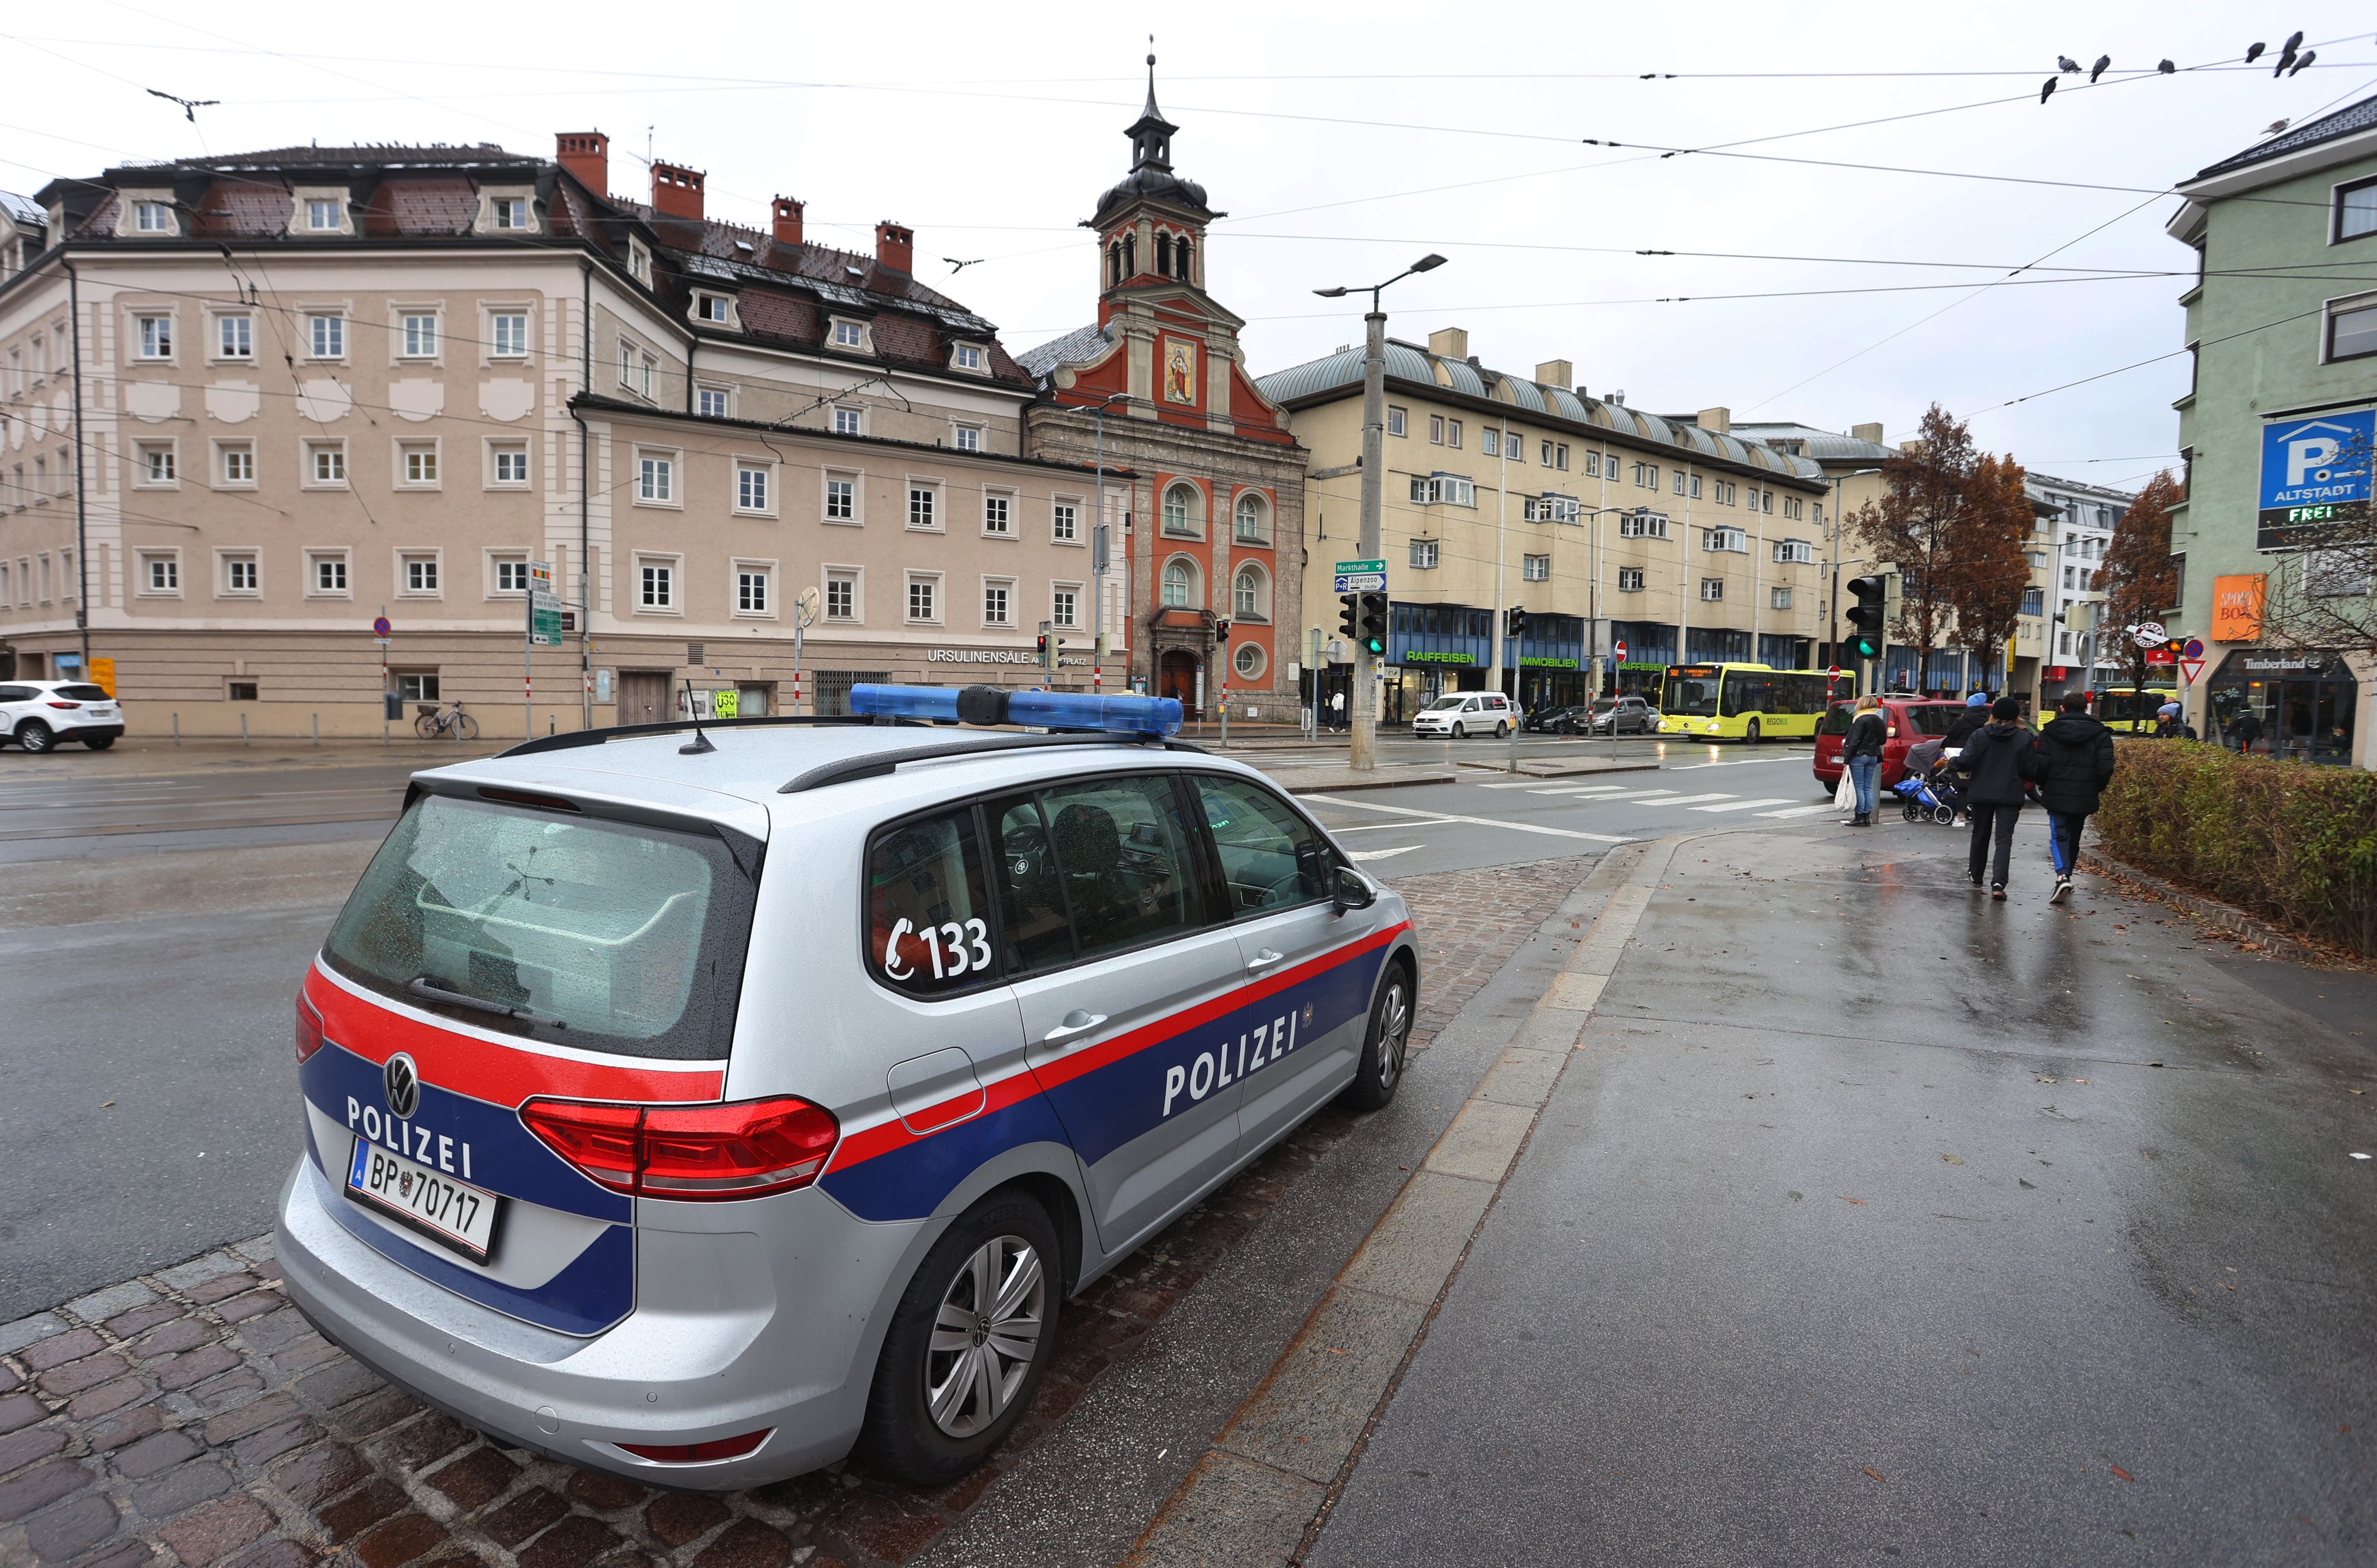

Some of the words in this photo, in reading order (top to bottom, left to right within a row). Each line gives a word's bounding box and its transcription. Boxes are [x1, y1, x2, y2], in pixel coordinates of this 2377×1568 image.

[2274, 484, 2356, 501] ALTSTADT
[2290, 506, 2333, 522] FREI
[1337, 563, 1369, 572] Markthalle
[2220, 591, 2254, 607] SPORT
[2220, 607, 2251, 620] BOX
[928, 649, 1029, 664] URSULINENSÄLE
[1407, 651, 1475, 663] RAIFFEISEN
[1520, 656, 1579, 668] IMMOBILIEN
[2243, 657, 2306, 669] Timberland
[1385, 667, 1397, 676] NEO
[919, 918, 991, 979] 133
[1163, 1010, 1297, 1117] POLIZEI
[348, 1095, 471, 1179] POLIZEI
[355, 1169, 361, 1181] A
[370, 1153, 398, 1194] BP
[411, 1171, 480, 1233] 70717
